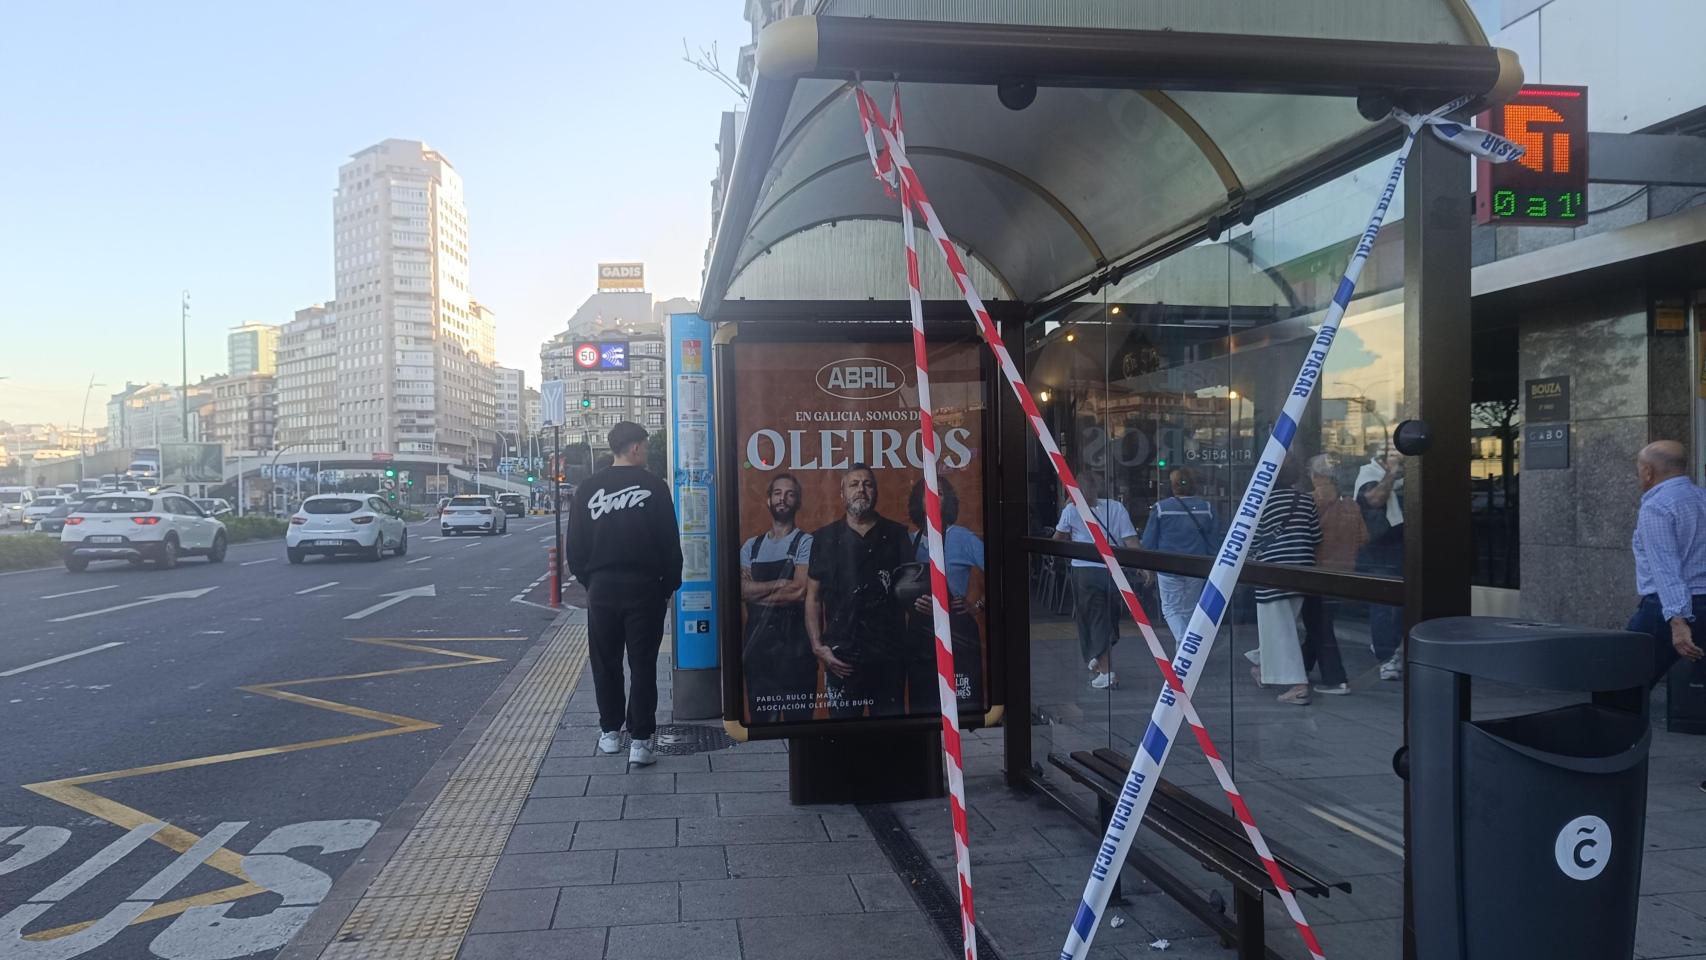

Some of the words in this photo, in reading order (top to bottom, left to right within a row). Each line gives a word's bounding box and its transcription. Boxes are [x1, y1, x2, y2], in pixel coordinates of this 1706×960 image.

[1494, 191, 1515, 216] 0
[1527, 197, 1547, 216] a
[602, 266, 641, 277] GADIS
[1316, 326, 1337, 347] NO
[581, 351, 595, 361] 50
[827, 366, 896, 389] ABRIL
[1292, 350, 1325, 399] PASAR
[1531, 382, 1561, 396] BOUZA
[796, 411, 814, 422] EN
[814, 410, 864, 423] GALICIA,
[866, 410, 907, 421] SOMOS
[746, 428, 972, 471] OLEIROS
[1240, 460, 1277, 518] POLICIA
[1218, 521, 1251, 568] LOCAL
[1182, 631, 1203, 655] NO
[1160, 656, 1192, 707] PAAR
[756, 695, 784, 703] PABLO,
[1110, 770, 1146, 830] POLICIA
[1088, 833, 1121, 882] LOCAL
